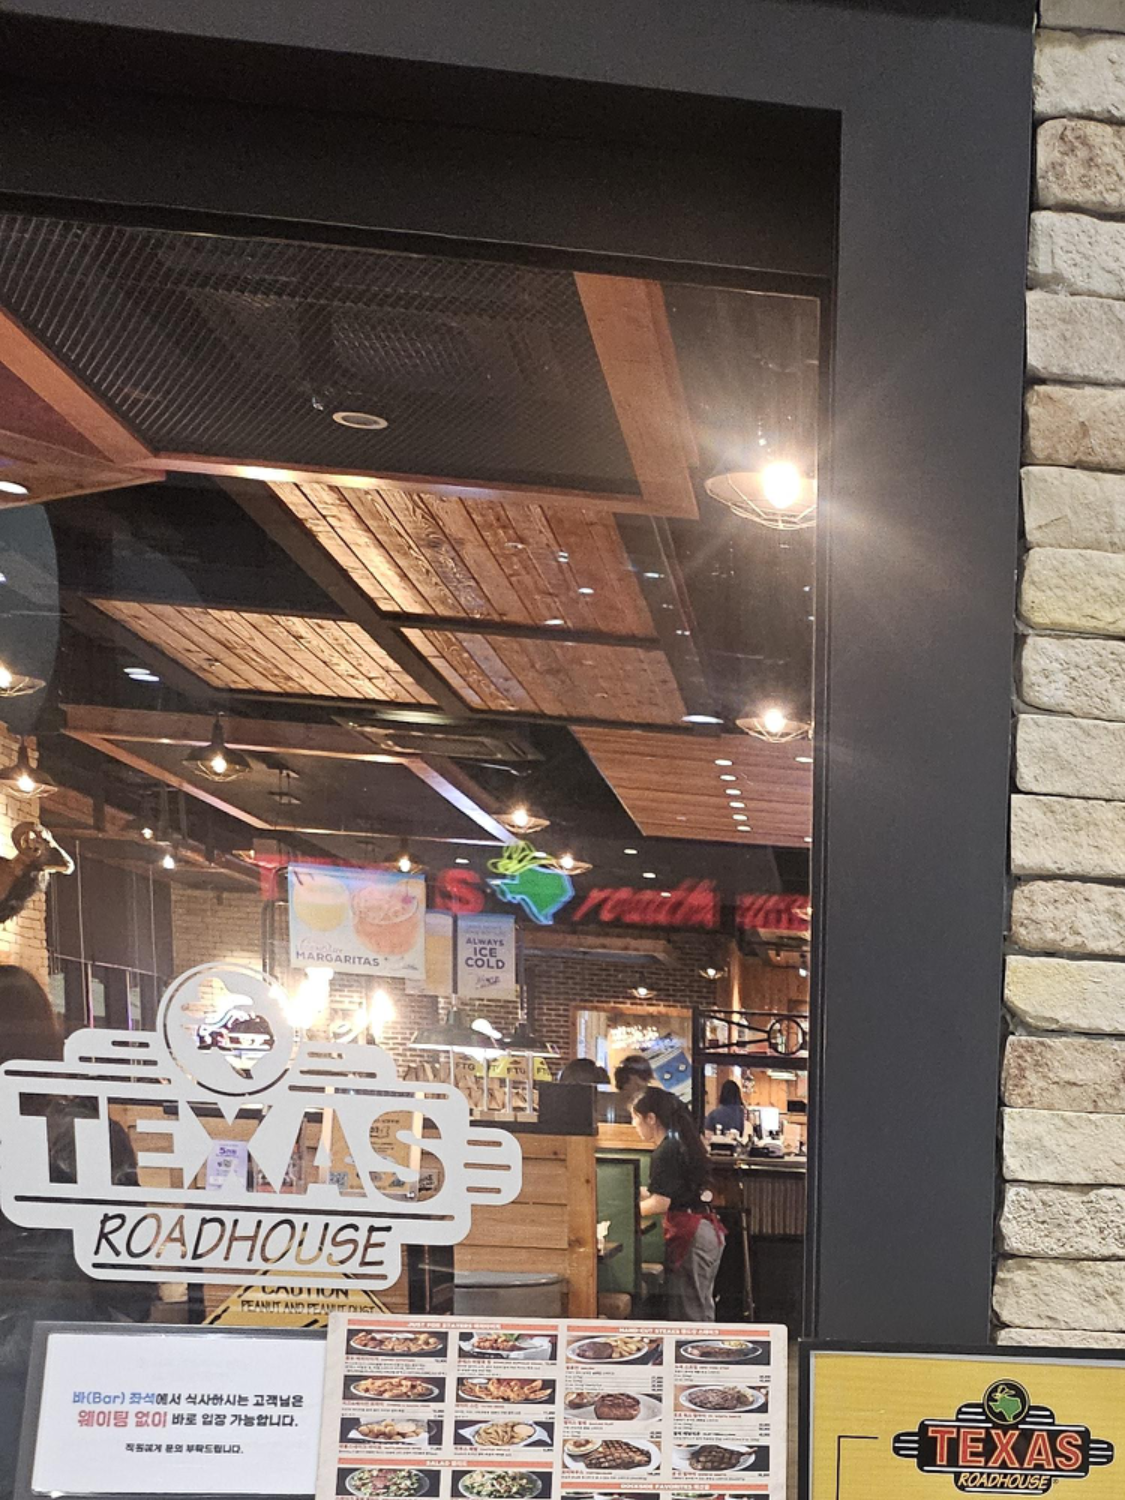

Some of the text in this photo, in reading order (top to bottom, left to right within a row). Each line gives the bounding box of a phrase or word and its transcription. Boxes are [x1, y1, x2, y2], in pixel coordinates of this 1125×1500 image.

[465, 937, 505, 947] ALWAYS
[296, 950, 380, 967] MARGARITAS
[473, 947, 498, 958] ICE
[465, 957, 506, 970] COLD
[19, 1092, 446, 1203] TEXAS
[95, 1212, 393, 1269] ROADHOUSE
[241, 1300, 281, 1313] PEANUT
[285, 1302, 304, 1314] AND
[307, 1303, 346, 1314] PEANUT
[72, 1391, 304, 1408] 바(Bar) 좌석에서 식사하시는 고객님은
[78, 1410, 299, 1428] 웨이팅 없이 바로 입장 가능합니다.
[165, 1444, 183, 1454] 문의
[928, 1426, 1083, 1470] TEXAS
[958, 1473, 1049, 1490] ROADHOUSE
